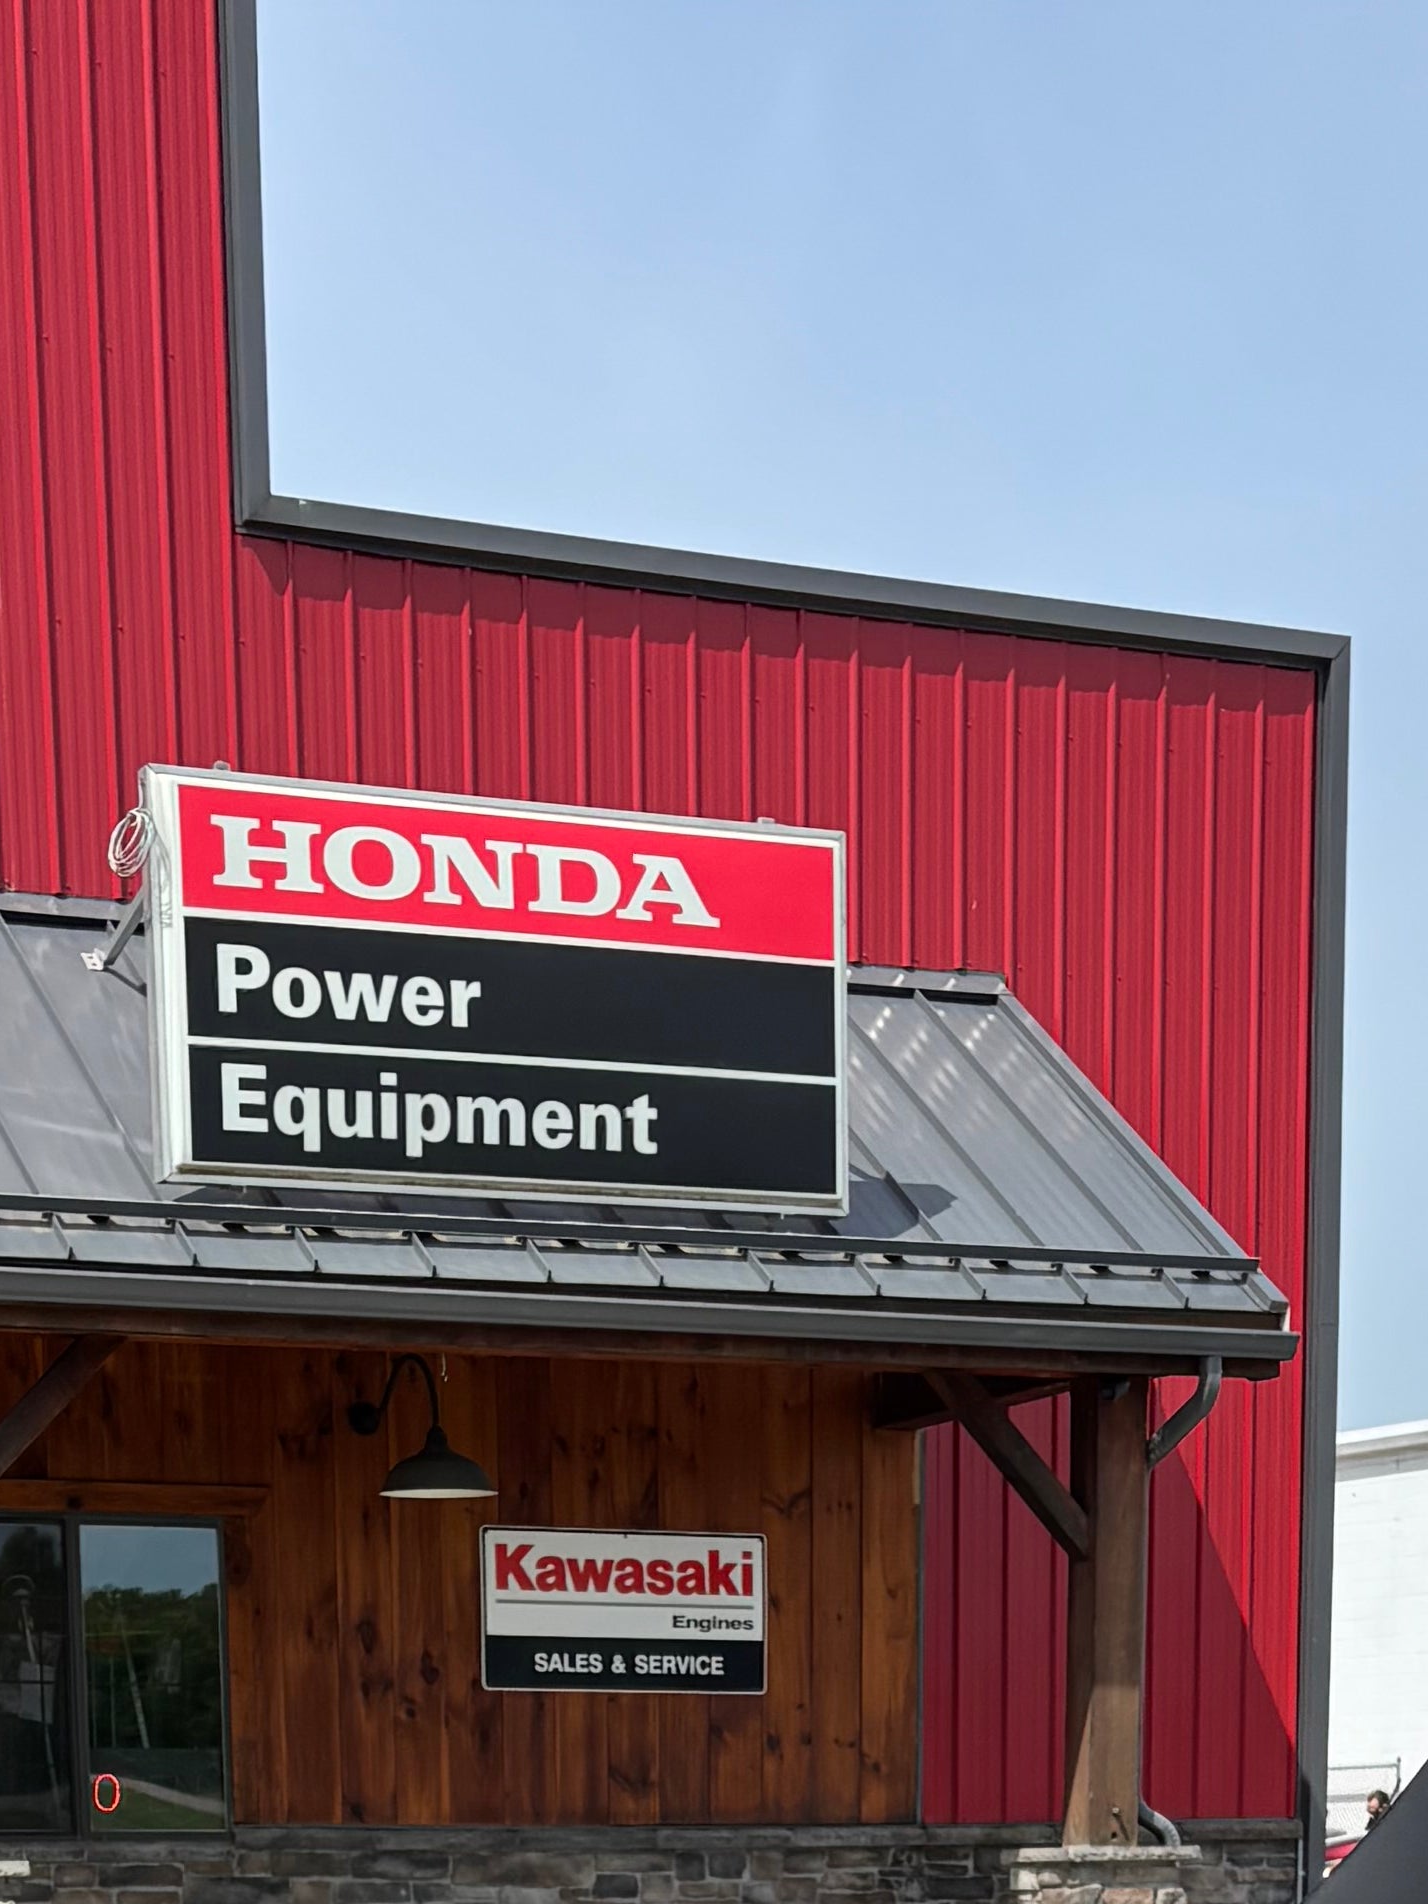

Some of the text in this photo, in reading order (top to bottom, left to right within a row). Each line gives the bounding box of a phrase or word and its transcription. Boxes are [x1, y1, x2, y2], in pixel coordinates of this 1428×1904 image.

[210, 813, 721, 928] HONDA
[216, 943, 482, 1028] Power
[220, 1062, 659, 1158] Equipment
[494, 1543, 754, 1597] Kawasaki
[672, 1614, 754, 1633] Engines
[533, 1652, 725, 1676] SALES & SERVICE
